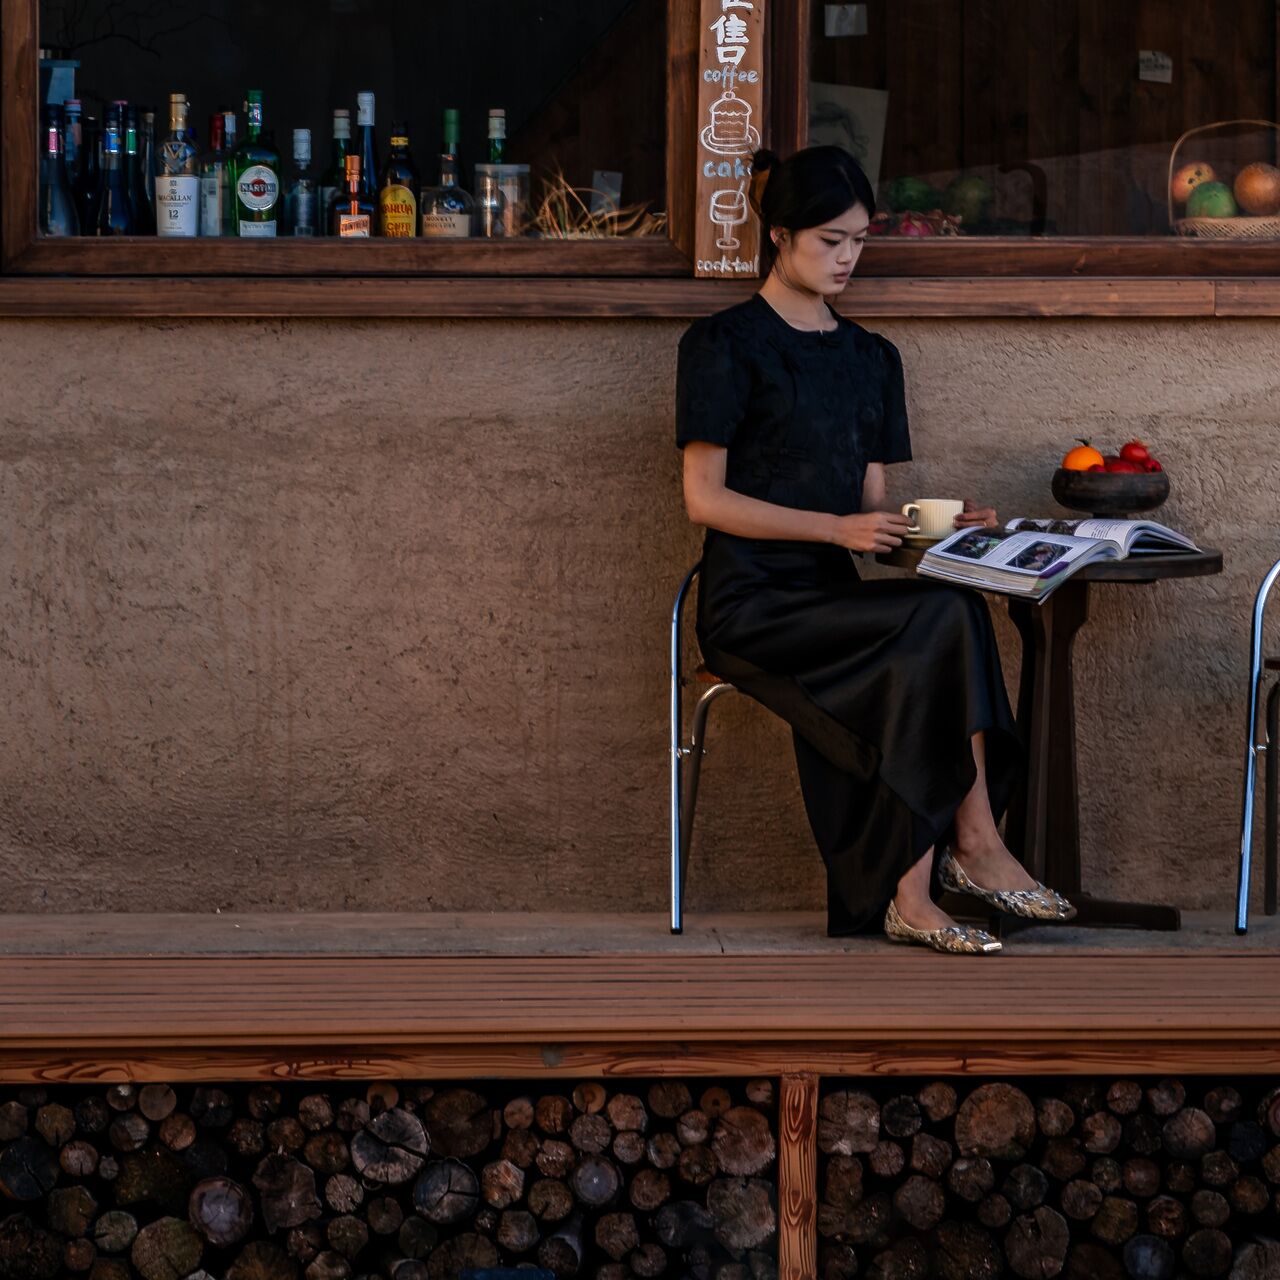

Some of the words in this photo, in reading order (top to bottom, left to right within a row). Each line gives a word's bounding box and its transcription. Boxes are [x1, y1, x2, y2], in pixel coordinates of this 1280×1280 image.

[703, 64, 759, 88] coffee
[703, 157, 752, 180] cak
[169, 209, 179, 219] 12
[696, 254, 760, 273] cocktail
